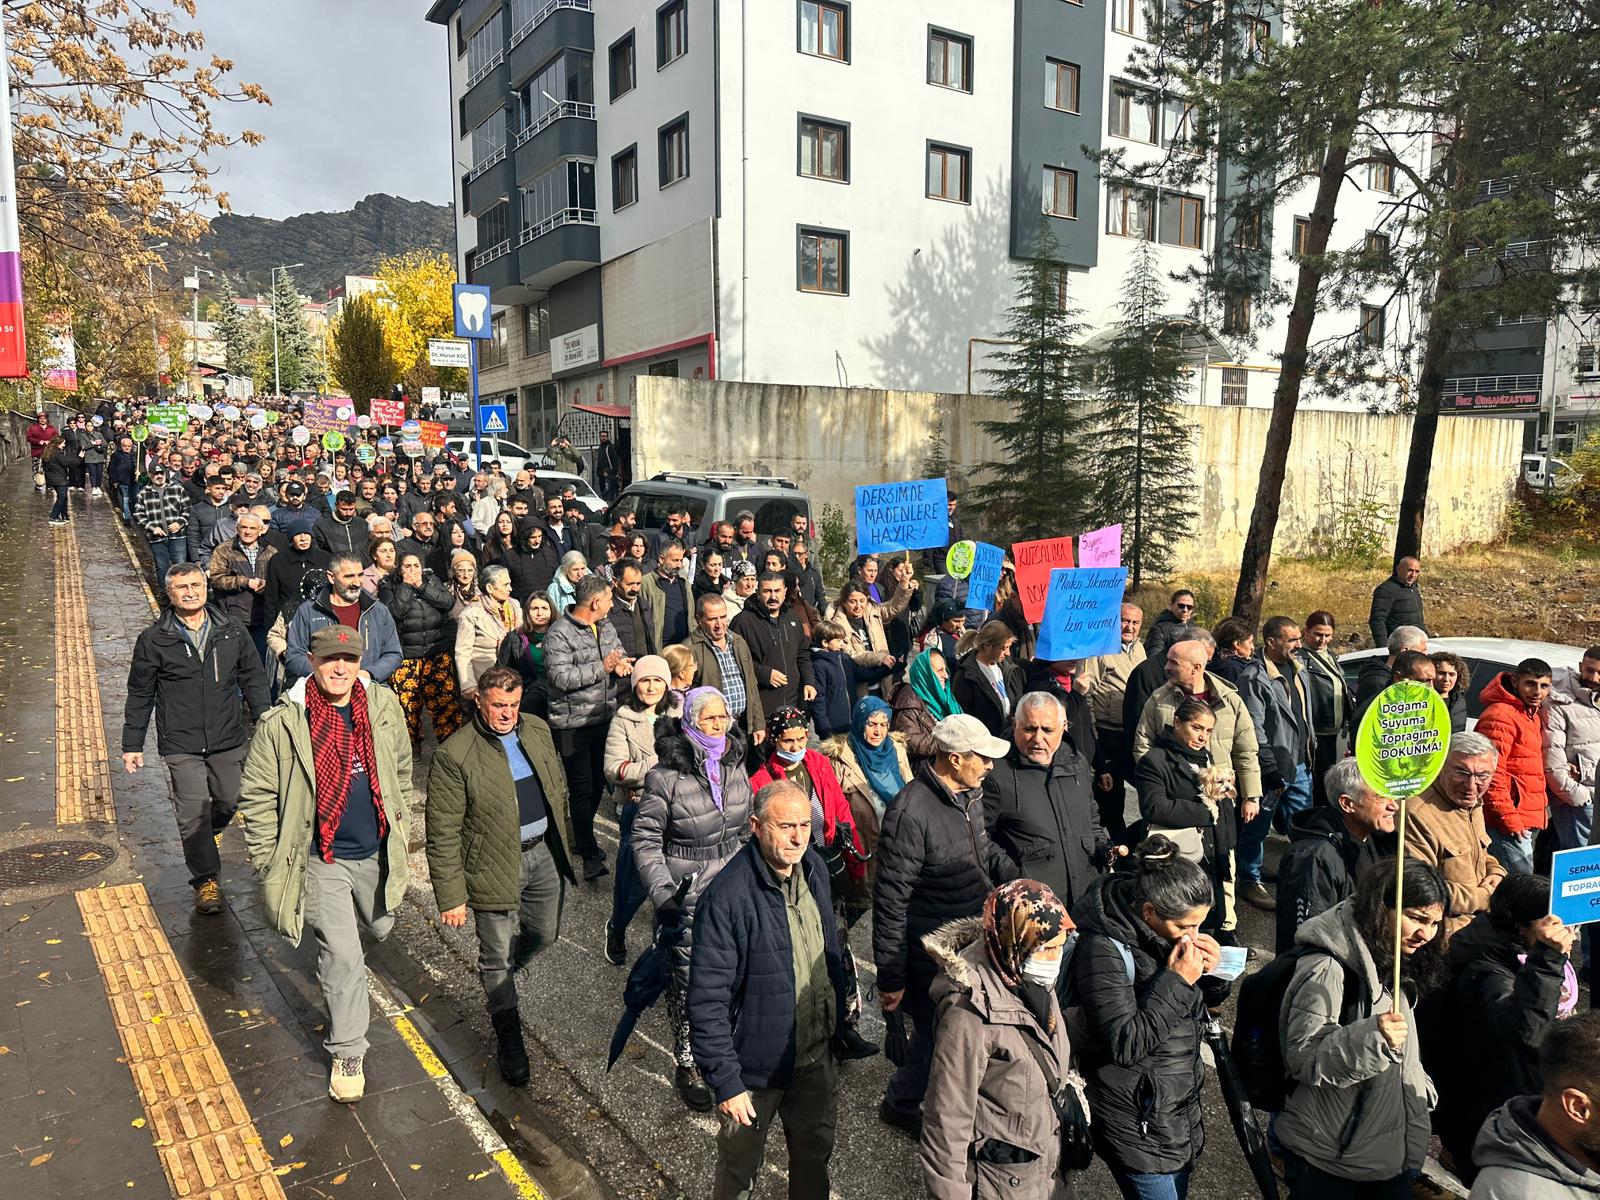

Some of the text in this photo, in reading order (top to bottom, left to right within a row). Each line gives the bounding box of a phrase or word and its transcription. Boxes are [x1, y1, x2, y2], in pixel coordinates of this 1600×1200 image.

[865, 502, 939, 526] MADENLERE
[871, 524, 917, 545] HAYIR
[1019, 542, 1068, 567] KUTSALIMA
[1055, 571, 1083, 591] Maden
[1026, 583, 1049, 604] DOK
[1382, 700, 1428, 715] Doğama
[1381, 715, 1426, 729] Suyuma
[1381, 741, 1442, 759] DOKUNMA!
